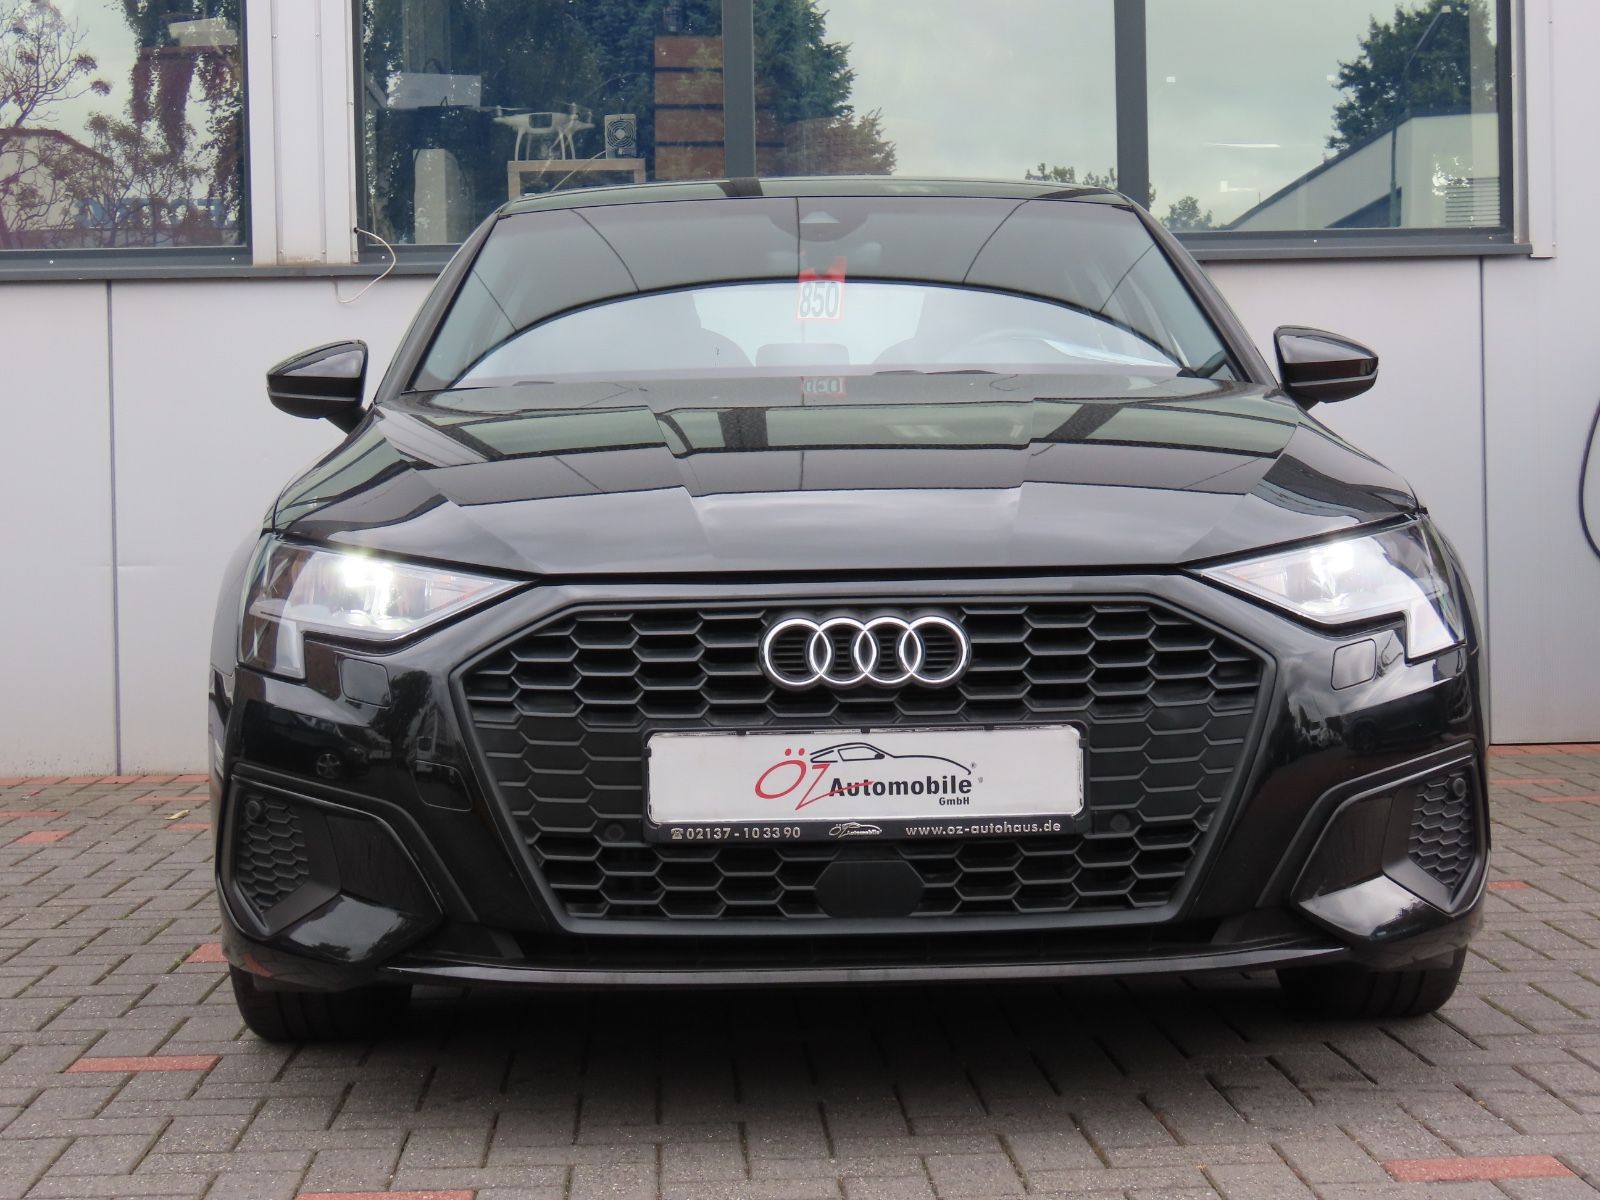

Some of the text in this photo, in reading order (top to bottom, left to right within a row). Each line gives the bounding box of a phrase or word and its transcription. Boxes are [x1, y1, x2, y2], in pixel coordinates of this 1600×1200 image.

[800, 282, 839, 318] 850
[829, 775, 972, 797] Automobile
[938, 796, 970, 806] GmbH
[905, 820, 1061, 836] www.oz-autohaus.de
